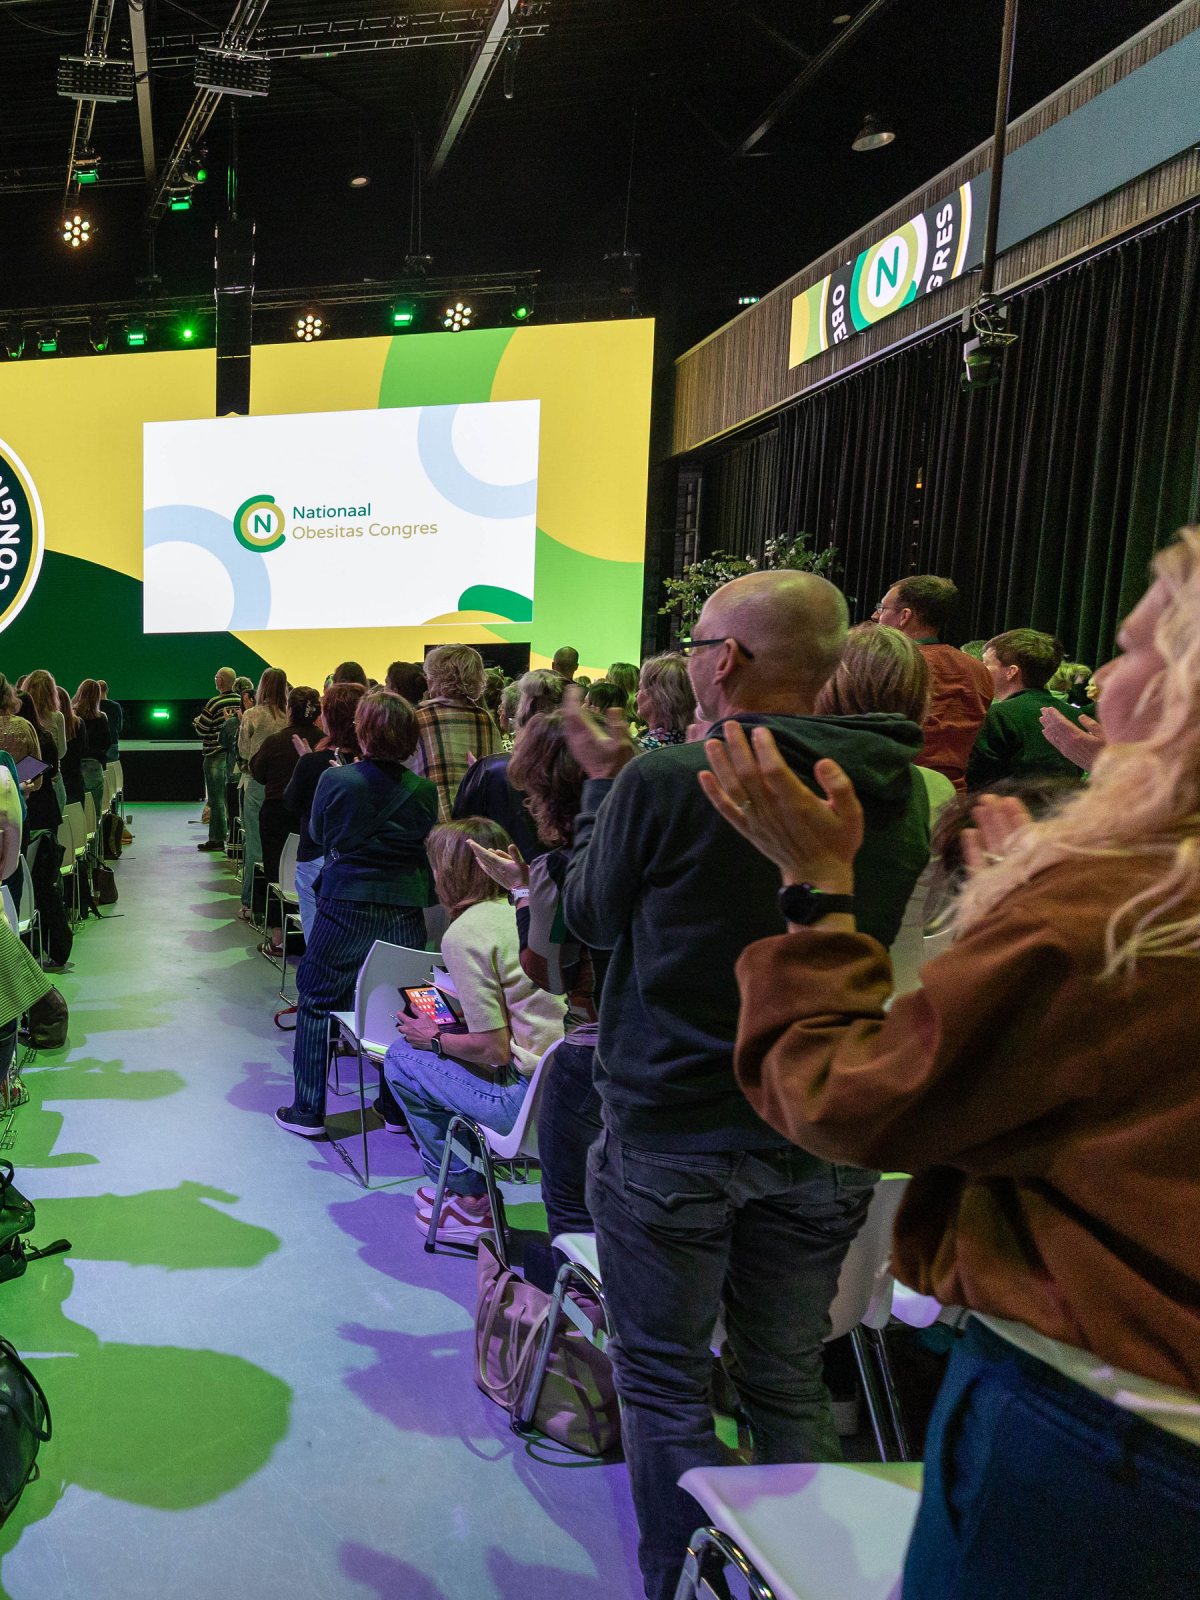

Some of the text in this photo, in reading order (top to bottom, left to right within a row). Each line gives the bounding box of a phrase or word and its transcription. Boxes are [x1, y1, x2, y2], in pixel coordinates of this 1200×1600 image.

[876, 246, 899, 297] N
[832, 284, 849, 344] OBE
[292, 503, 371, 519] Nationaal
[254, 514, 271, 534] N
[292, 523, 438, 540] Obesitas Congres
